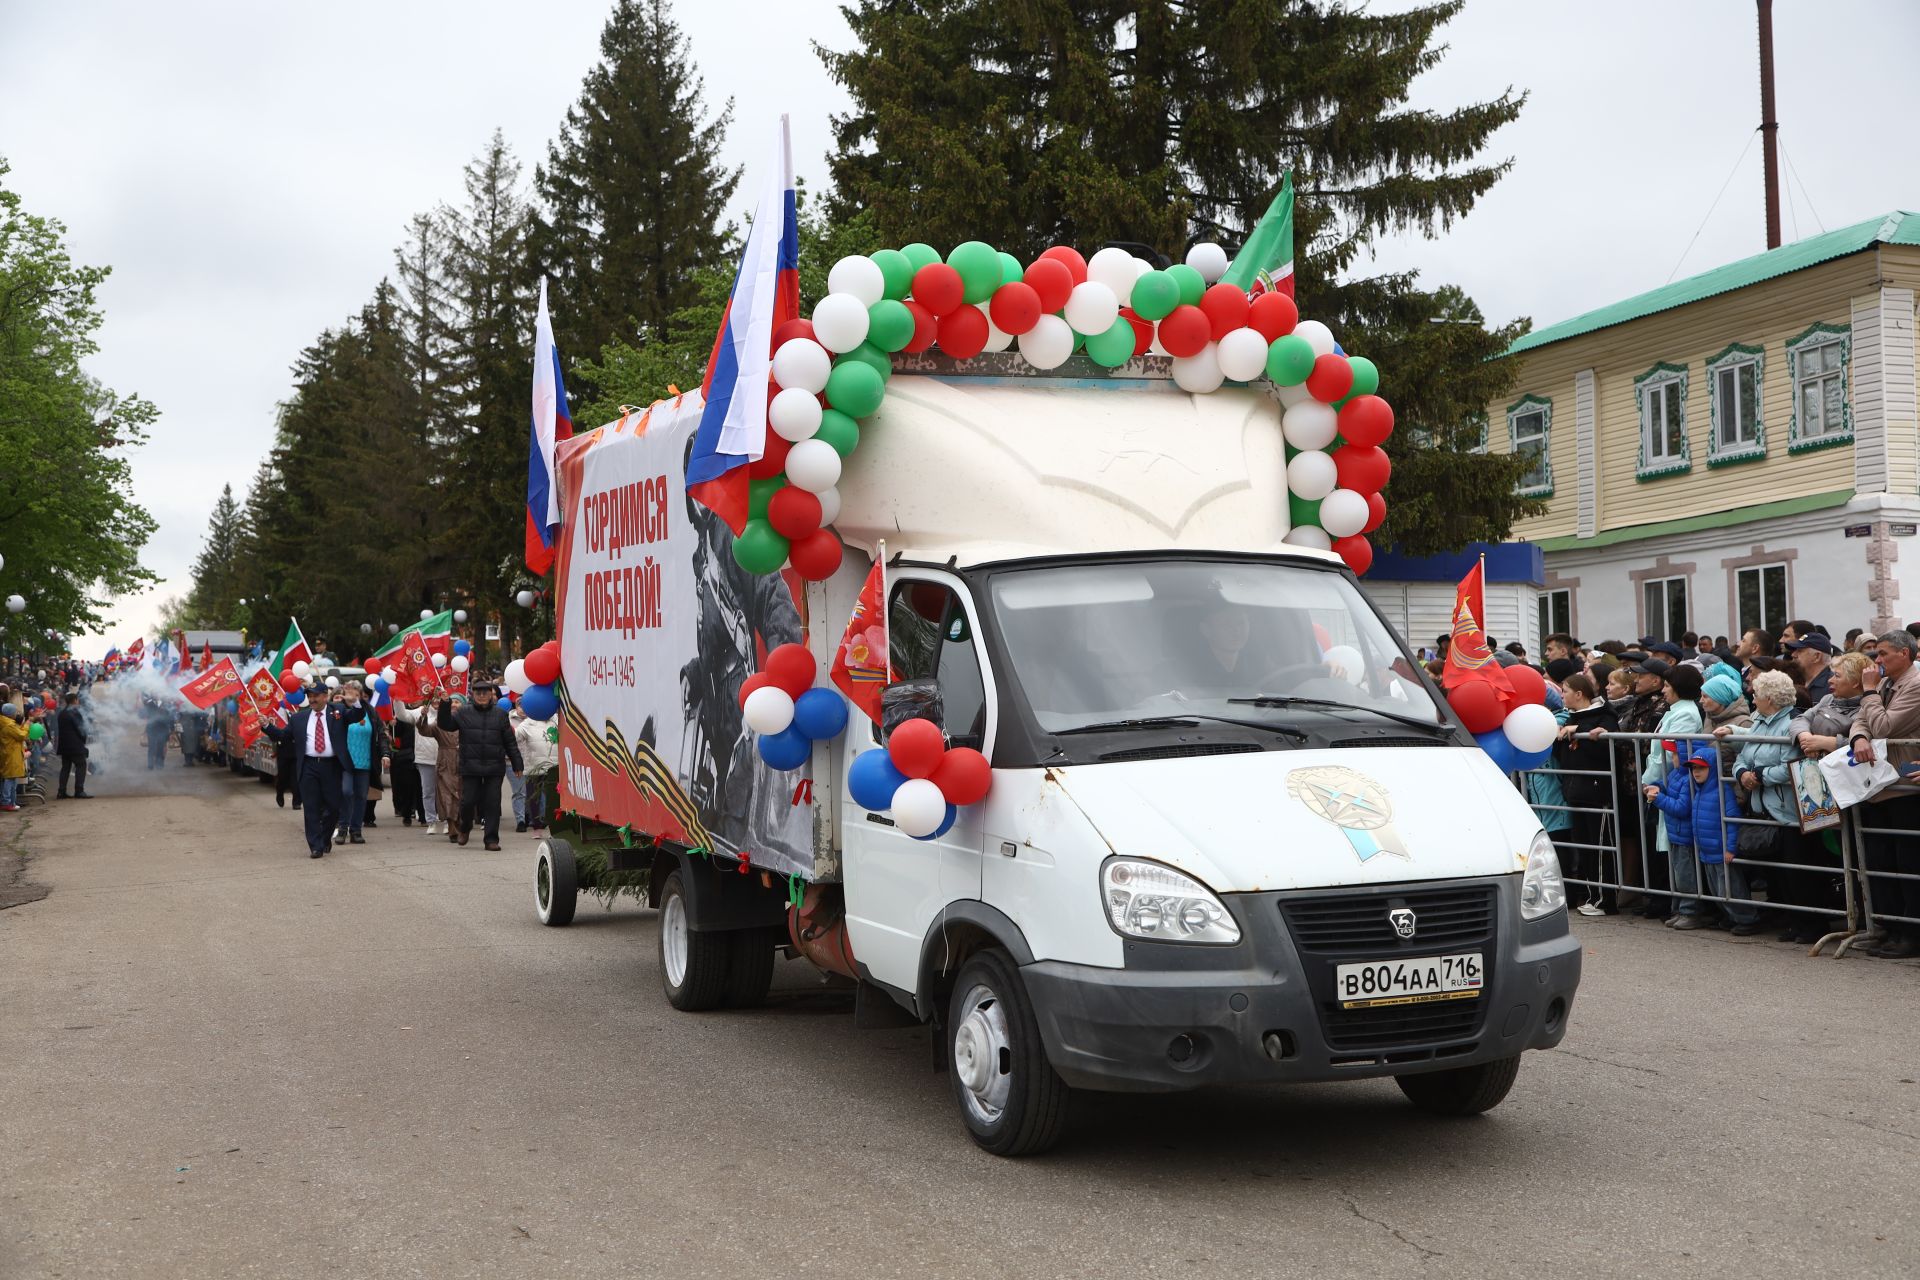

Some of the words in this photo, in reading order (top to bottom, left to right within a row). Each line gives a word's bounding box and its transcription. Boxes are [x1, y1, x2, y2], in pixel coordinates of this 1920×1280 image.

[583, 474, 668, 560] ГОРДИМСЯ
[584, 556, 662, 640] ПОБЕДОЙ!
[564, 746, 574, 796] 9
[575, 763, 595, 801] МАЯ
[1443, 956, 1477, 979] 716
[1451, 979, 1468, 987] RUS
